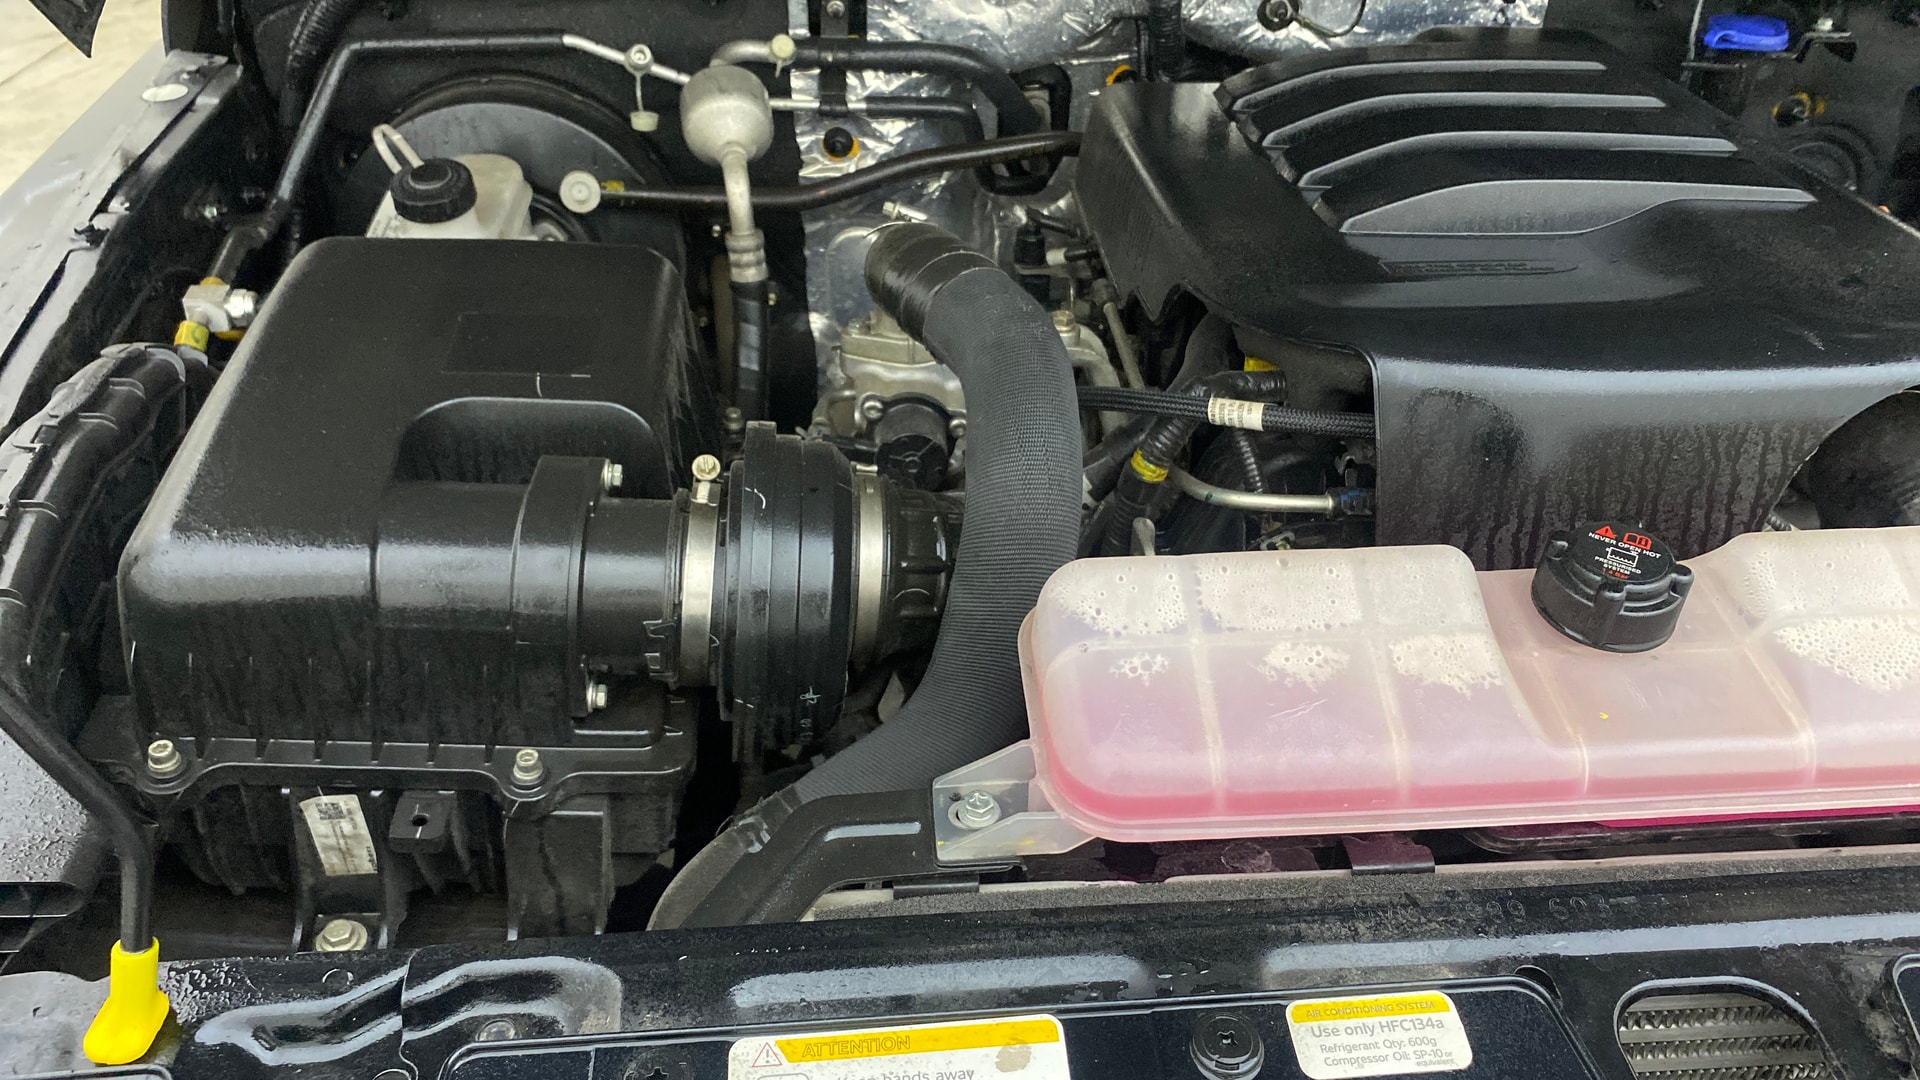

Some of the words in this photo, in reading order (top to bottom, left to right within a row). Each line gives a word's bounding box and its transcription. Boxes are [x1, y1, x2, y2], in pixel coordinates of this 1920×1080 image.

[1588, 532, 1616, 545] NEVER
[1618, 541, 1641, 552] OPEN
[1643, 550, 1661, 558] HOT
[1595, 556, 1642, 574] PRESSURISED
[1603, 563, 1630, 575] SYSTEM
[1307, 1009, 1320, 1017] AIR
[1324, 1004, 1394, 1016] CONDITIONING
[1397, 1001, 1434, 1010] SYSTEM
[1310, 1025, 1340, 1038] Use
[1344, 1022, 1375, 1037] only
[1379, 1017, 1444, 1033] HFC134a
[802, 1035, 911, 1057] ATTENTION
[1320, 1041, 1381, 1053] Refrigerant
[1382, 1038, 1406, 1050] Qty:
[1408, 1036, 1437, 1047] 600g
[1324, 1054, 1389, 1067] Compressor
[1393, 1050, 1411, 1061] Oil:
[1413, 1048, 1443, 1059] SP-10
[936, 1069, 974, 1080] away
